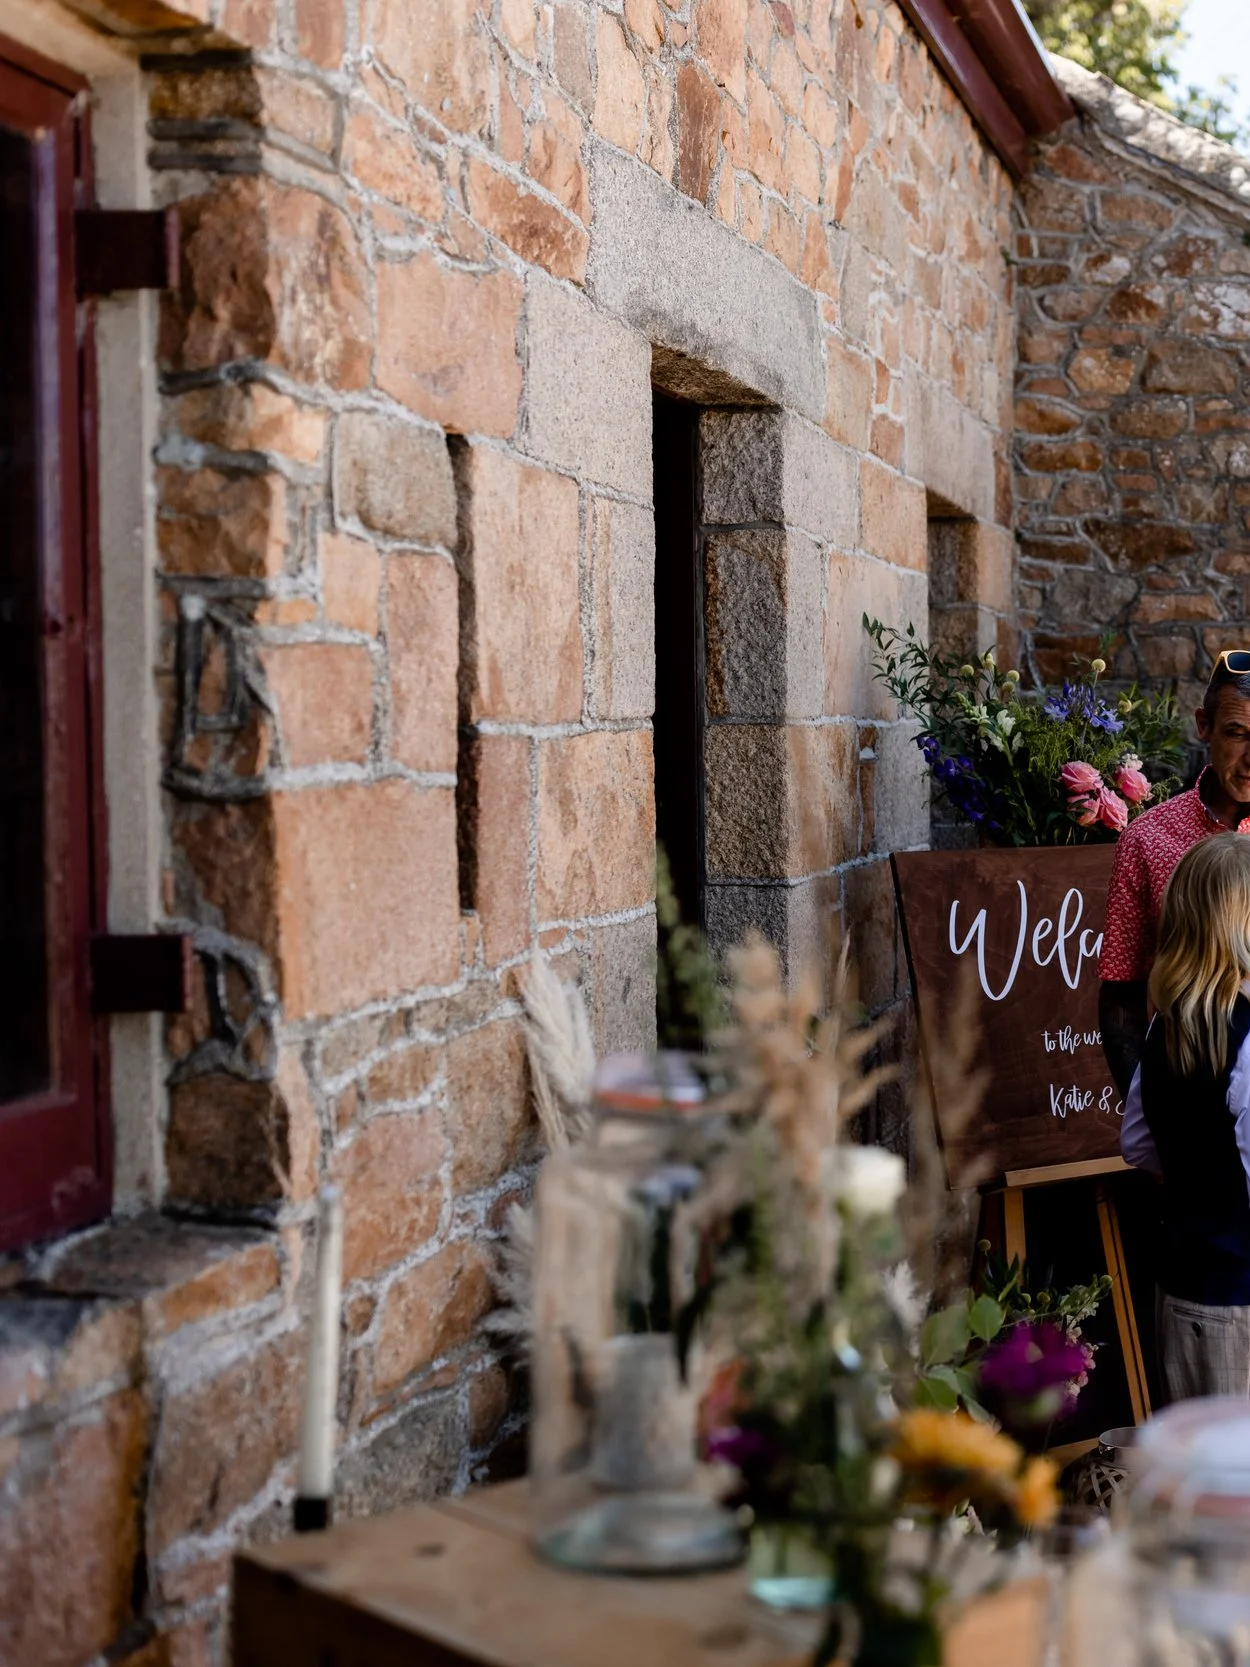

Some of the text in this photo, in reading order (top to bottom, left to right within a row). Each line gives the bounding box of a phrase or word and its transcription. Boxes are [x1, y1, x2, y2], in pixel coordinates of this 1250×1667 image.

[1041, 1030, 1056, 1053] to
[1056, 1025, 1082, 1055] the
[1049, 1083, 1095, 1119] Katie
[1098, 1085, 1114, 1114] &
